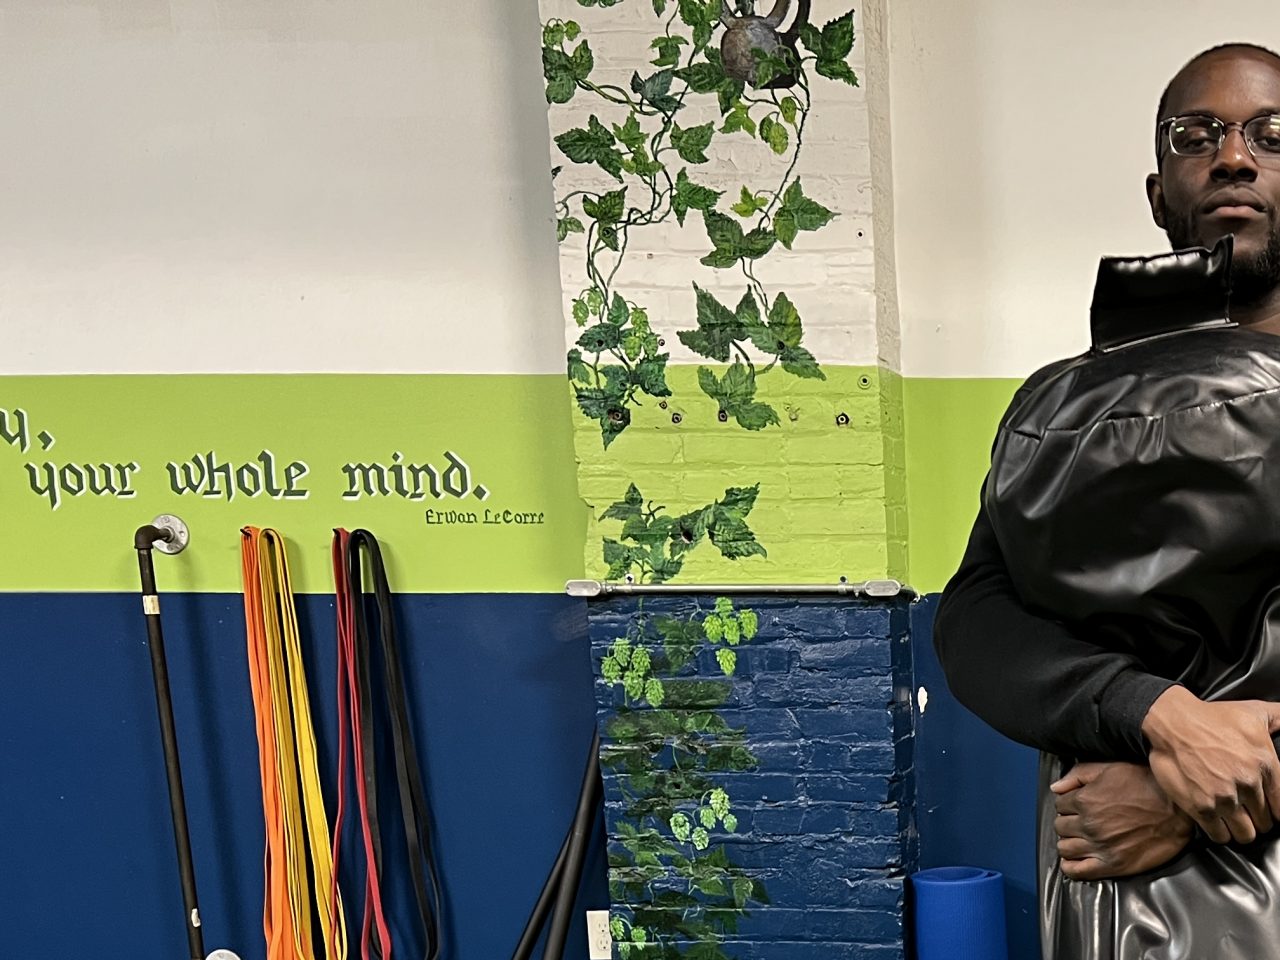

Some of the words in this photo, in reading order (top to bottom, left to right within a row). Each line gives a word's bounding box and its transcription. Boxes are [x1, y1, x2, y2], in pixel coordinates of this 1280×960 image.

[24, 461, 140, 511] your
[166, 450, 310, 502] whole
[341, 450, 490, 501] mind.
